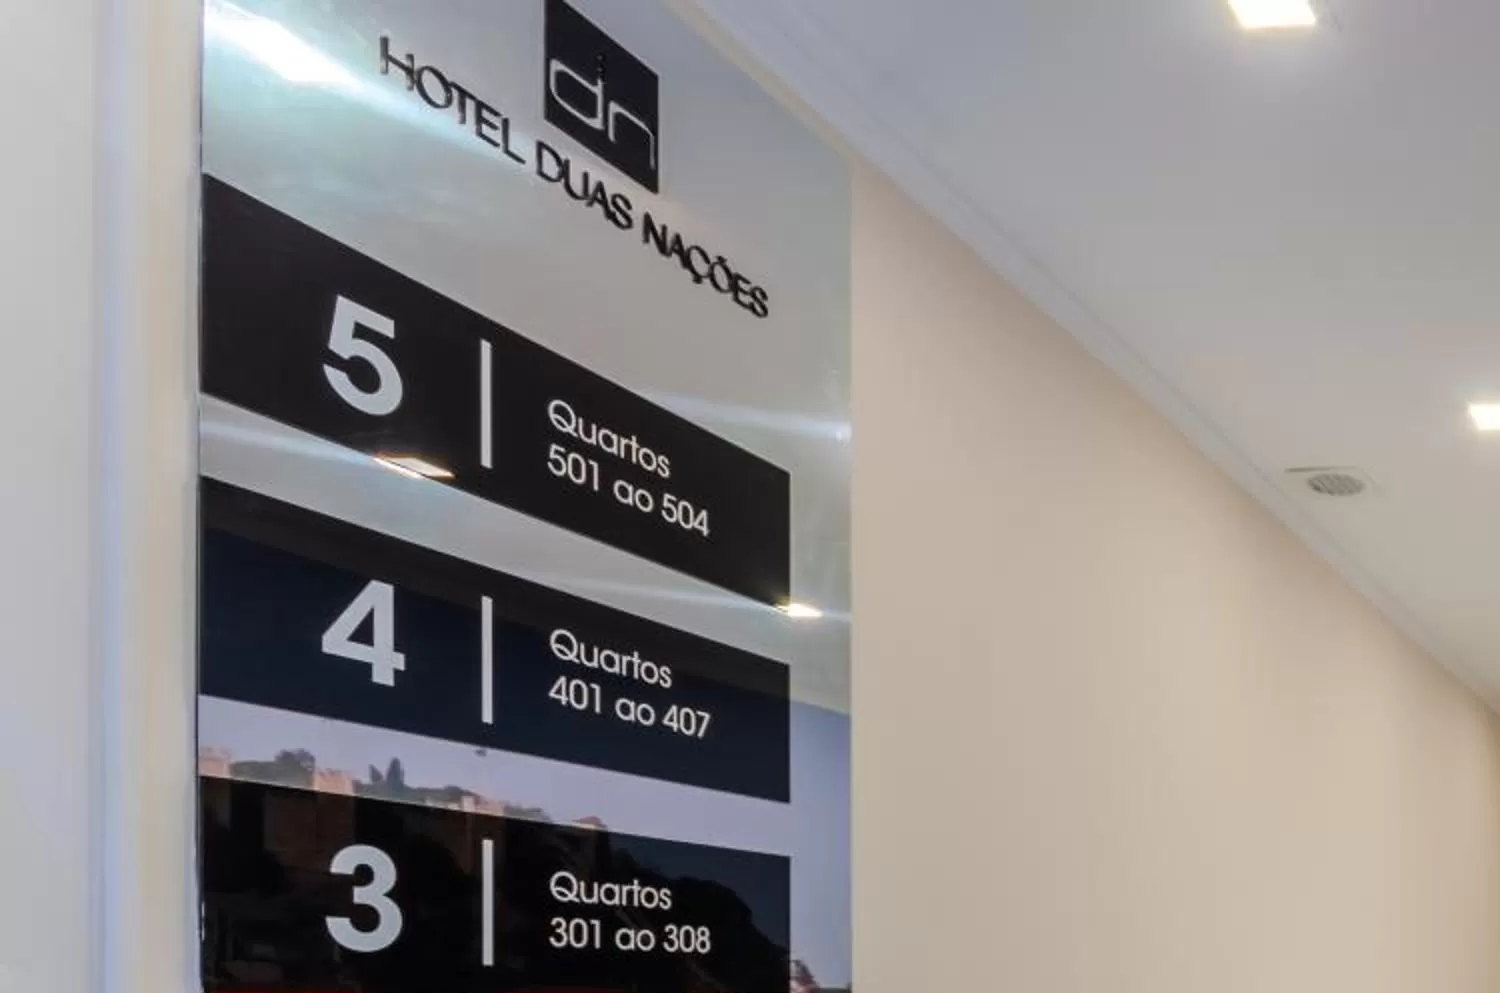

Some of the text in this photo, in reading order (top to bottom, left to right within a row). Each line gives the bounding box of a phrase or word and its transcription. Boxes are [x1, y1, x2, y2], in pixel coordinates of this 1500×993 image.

[380, 36, 769, 318] HOTEL DUAS NAÇÕES
[322, 295, 403, 416] 5
[547, 399, 670, 478] Quartos
[547, 444, 710, 536] 501 ao 504
[321, 579, 406, 687] 4
[549, 628, 672, 688] Quartos
[549, 676, 710, 739] 401 ao 407
[324, 844, 403, 953] 3
[549, 871, 672, 910] Quartos
[549, 918, 711, 954] 301 ao 308
